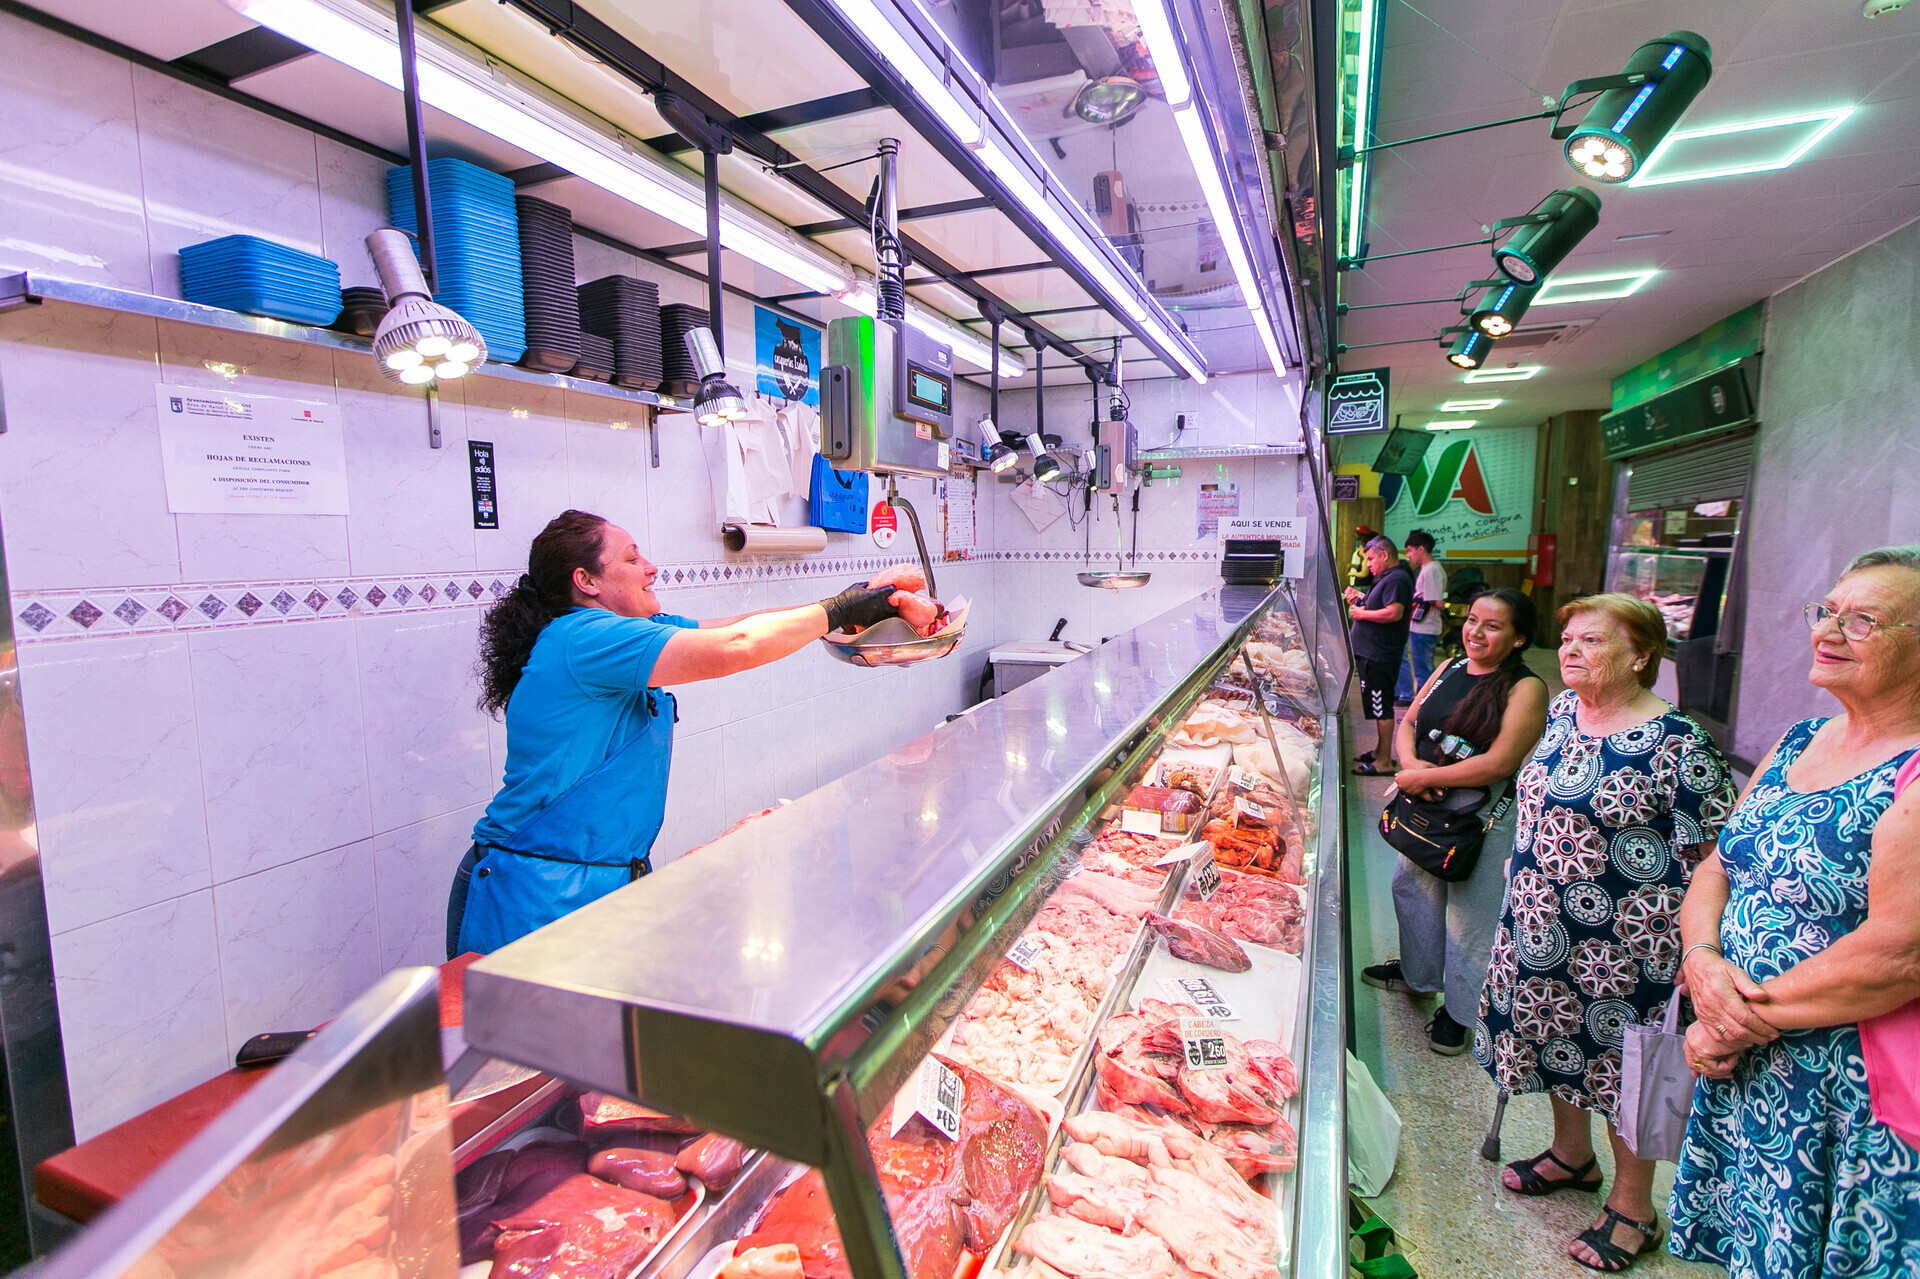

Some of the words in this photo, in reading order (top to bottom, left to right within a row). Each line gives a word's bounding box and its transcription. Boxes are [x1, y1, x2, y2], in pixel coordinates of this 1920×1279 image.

[243, 434, 275, 443] EXISTEN
[474, 449, 489, 458] Hola
[206, 454, 234, 462] HOJAS
[248, 456, 311, 466] RECLAMACIONES
[474, 465, 492, 473] adiós
[218, 476, 258, 484] DISPOSICIÓN
[1230, 520, 1250, 528] AQUI
[1252, 520, 1262, 528] SE
[1264, 520, 1292, 528] VENDE
[1458, 521, 1470, 531] la
[1476, 513, 1522, 526] compra
[1231, 533, 1264, 541] AUTENTICA
[1452, 525, 1510, 542] tradición
[1491, 796, 1513, 819] MBA
[1188, 1020, 1215, 1028] CABEZA
[1185, 1030, 1193, 1038] DE
[1193, 1029, 1222, 1038] CORDERO
